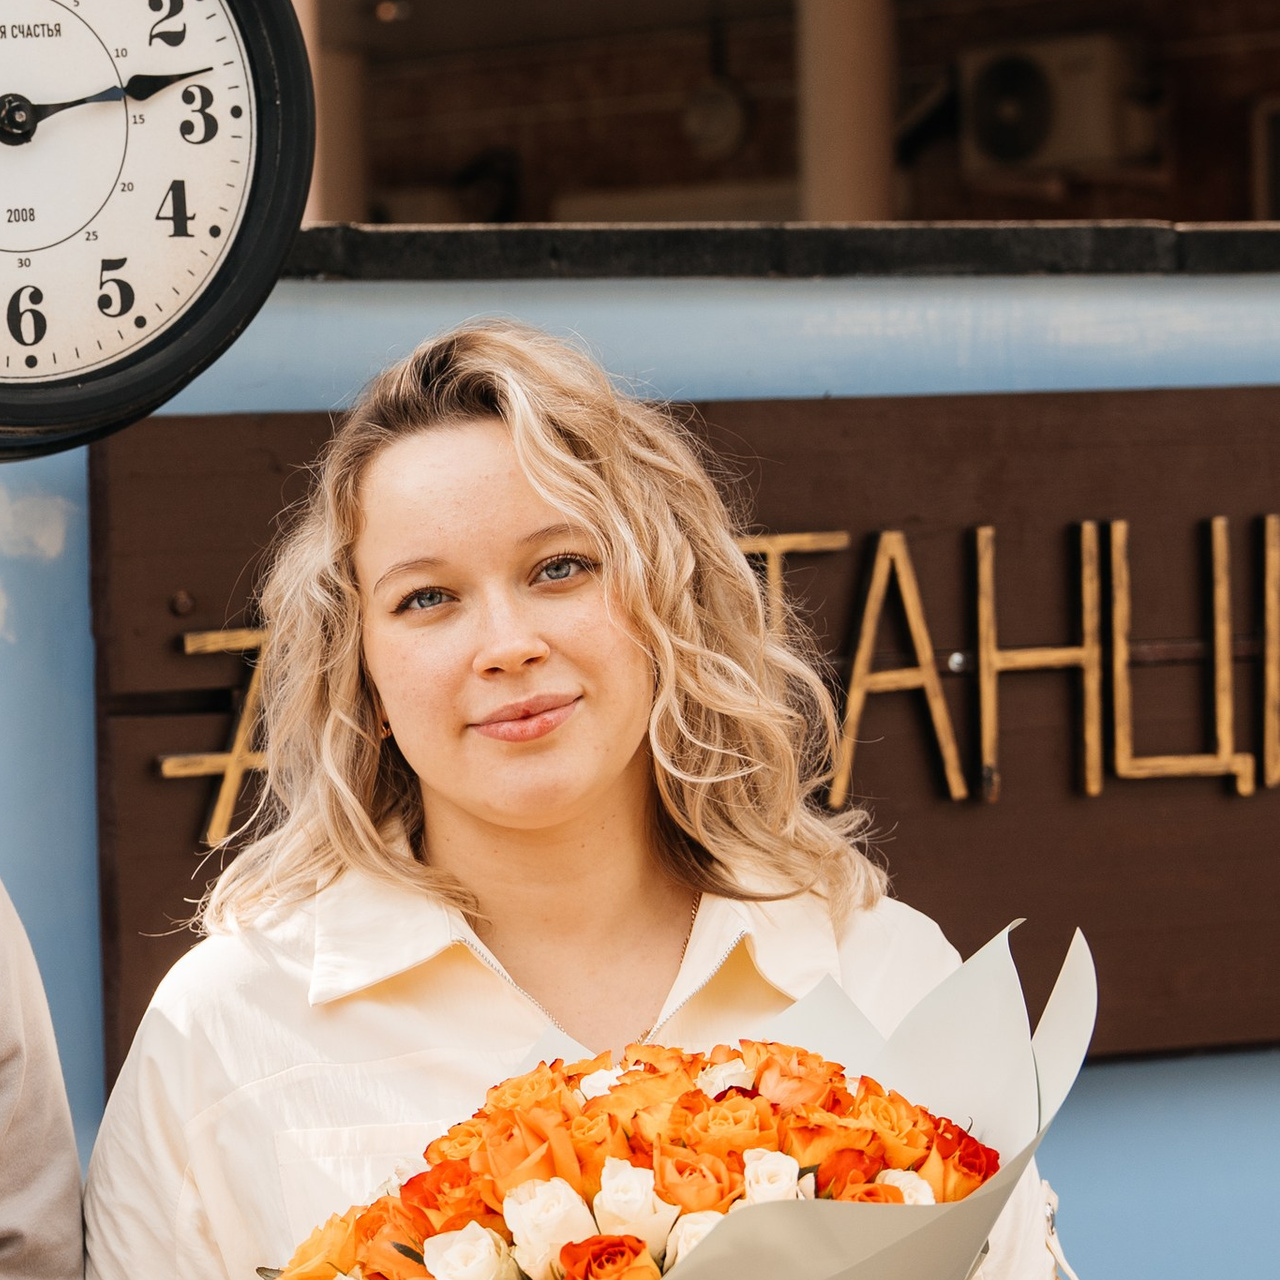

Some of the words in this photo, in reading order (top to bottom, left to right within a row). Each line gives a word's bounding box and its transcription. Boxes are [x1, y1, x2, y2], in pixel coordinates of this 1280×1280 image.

[10, 22, 62, 39] СЧАСТЬЯ
[115, 47, 128, 59] 10
[132, 113, 146, 125] 15
[178, 83, 219, 145] 3
[120, 181, 135, 193] 20
[6, 207, 36, 224] 2008
[155, 179, 197, 238] 4
[85, 230, 99, 242] 25
[17, 257, 32, 269] 30
[97, 257, 135, 318] 5
[6, 284, 48, 347] 6
